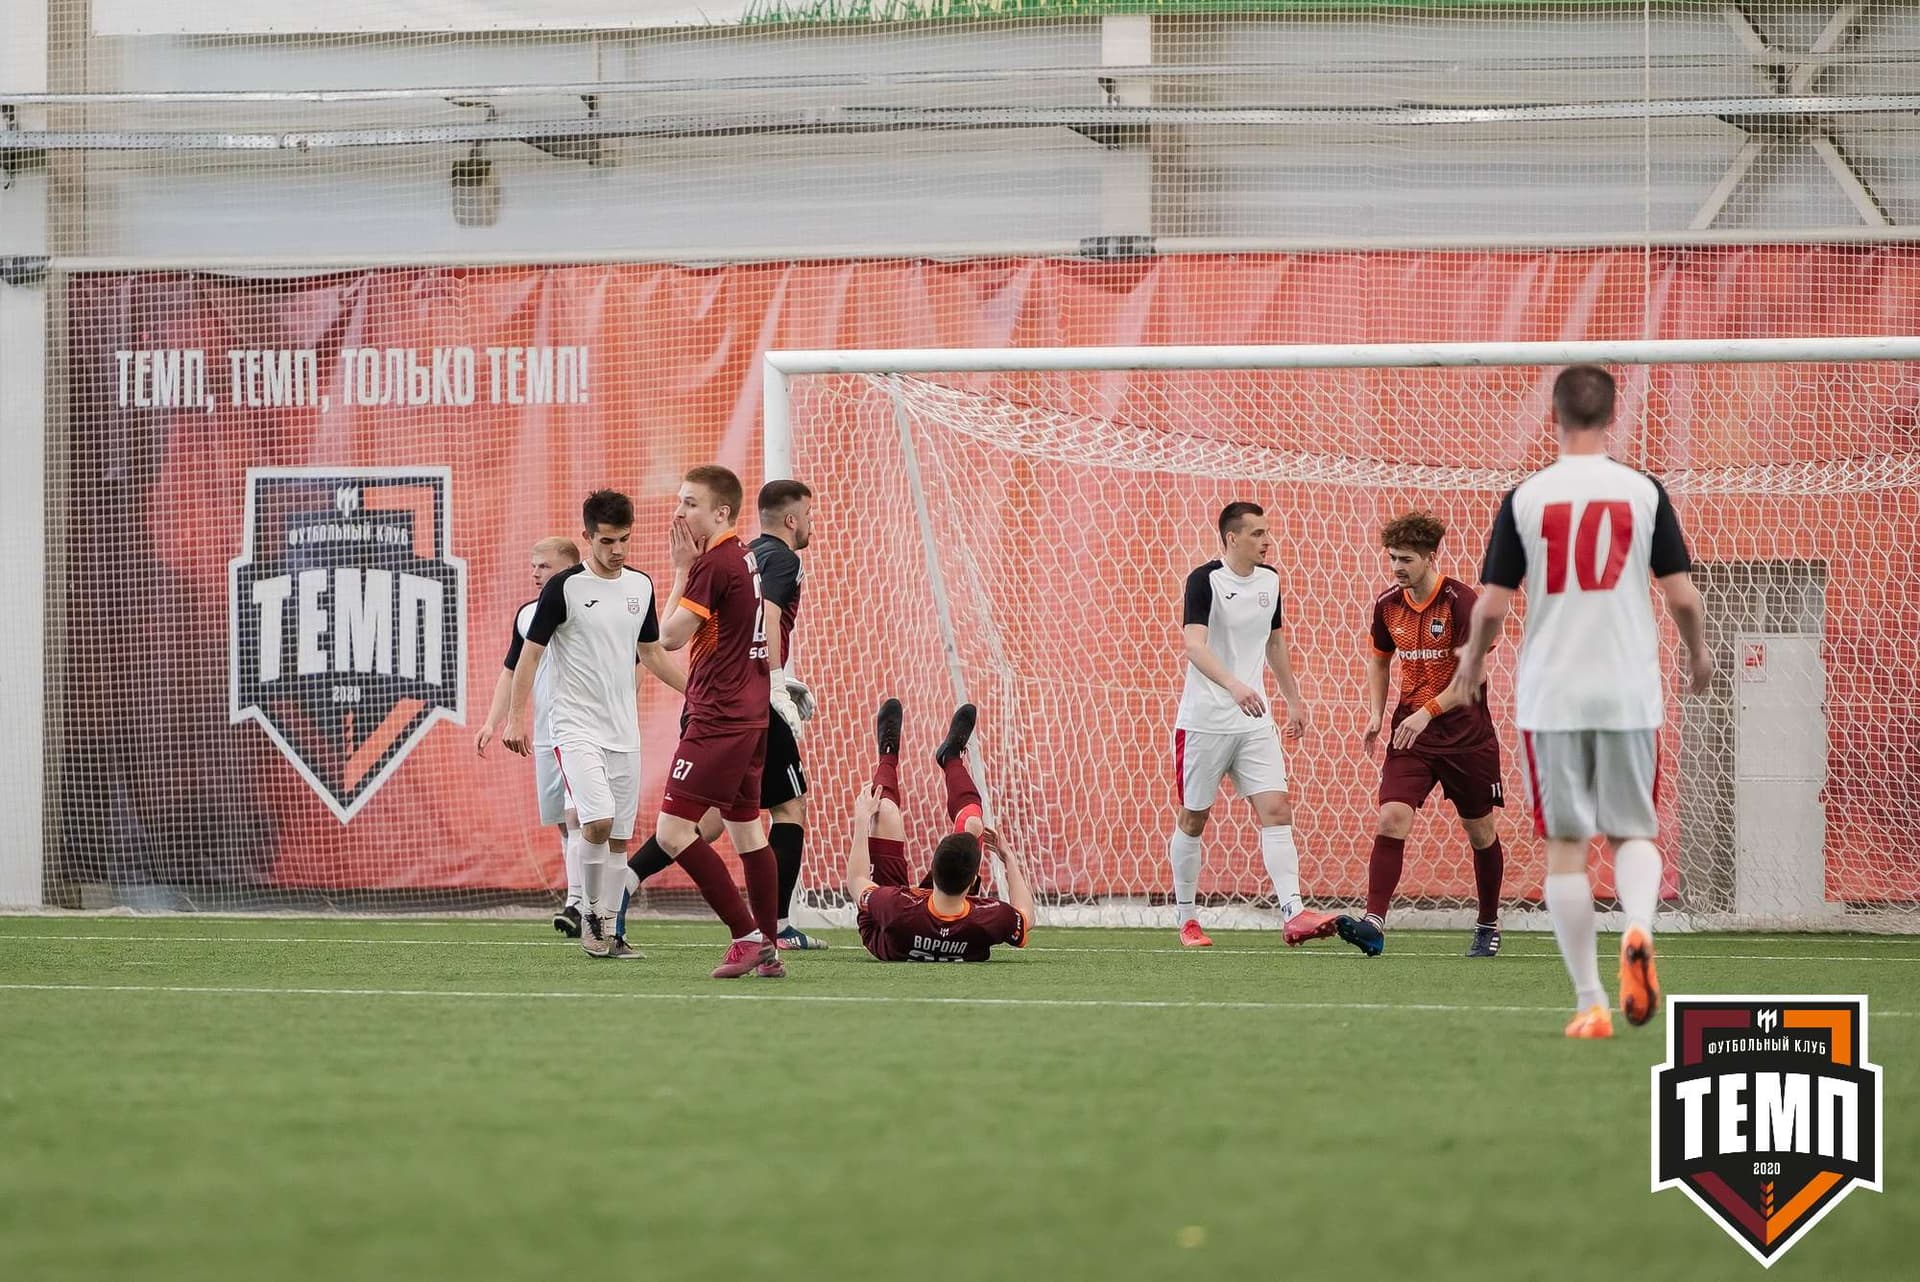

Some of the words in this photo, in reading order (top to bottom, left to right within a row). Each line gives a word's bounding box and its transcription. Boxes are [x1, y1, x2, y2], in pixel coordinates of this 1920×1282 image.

[115, 350, 215, 412] ТЕМП,
[228, 349, 330, 412] ТЕМП,
[341, 347, 474, 406] ТОЛЬКО
[486, 345, 588, 405] ТЕМП!
[289, 520, 371, 545] ФУТБОЛЬНЫЙ
[376, 525, 408, 545] КЛУБ
[1541, 501, 1633, 595] 10
[252, 567, 443, 687] ТЕМП
[332, 685, 361, 702] 2020
[672, 758, 694, 781] 27
[1490, 782, 1501, 799] 11
